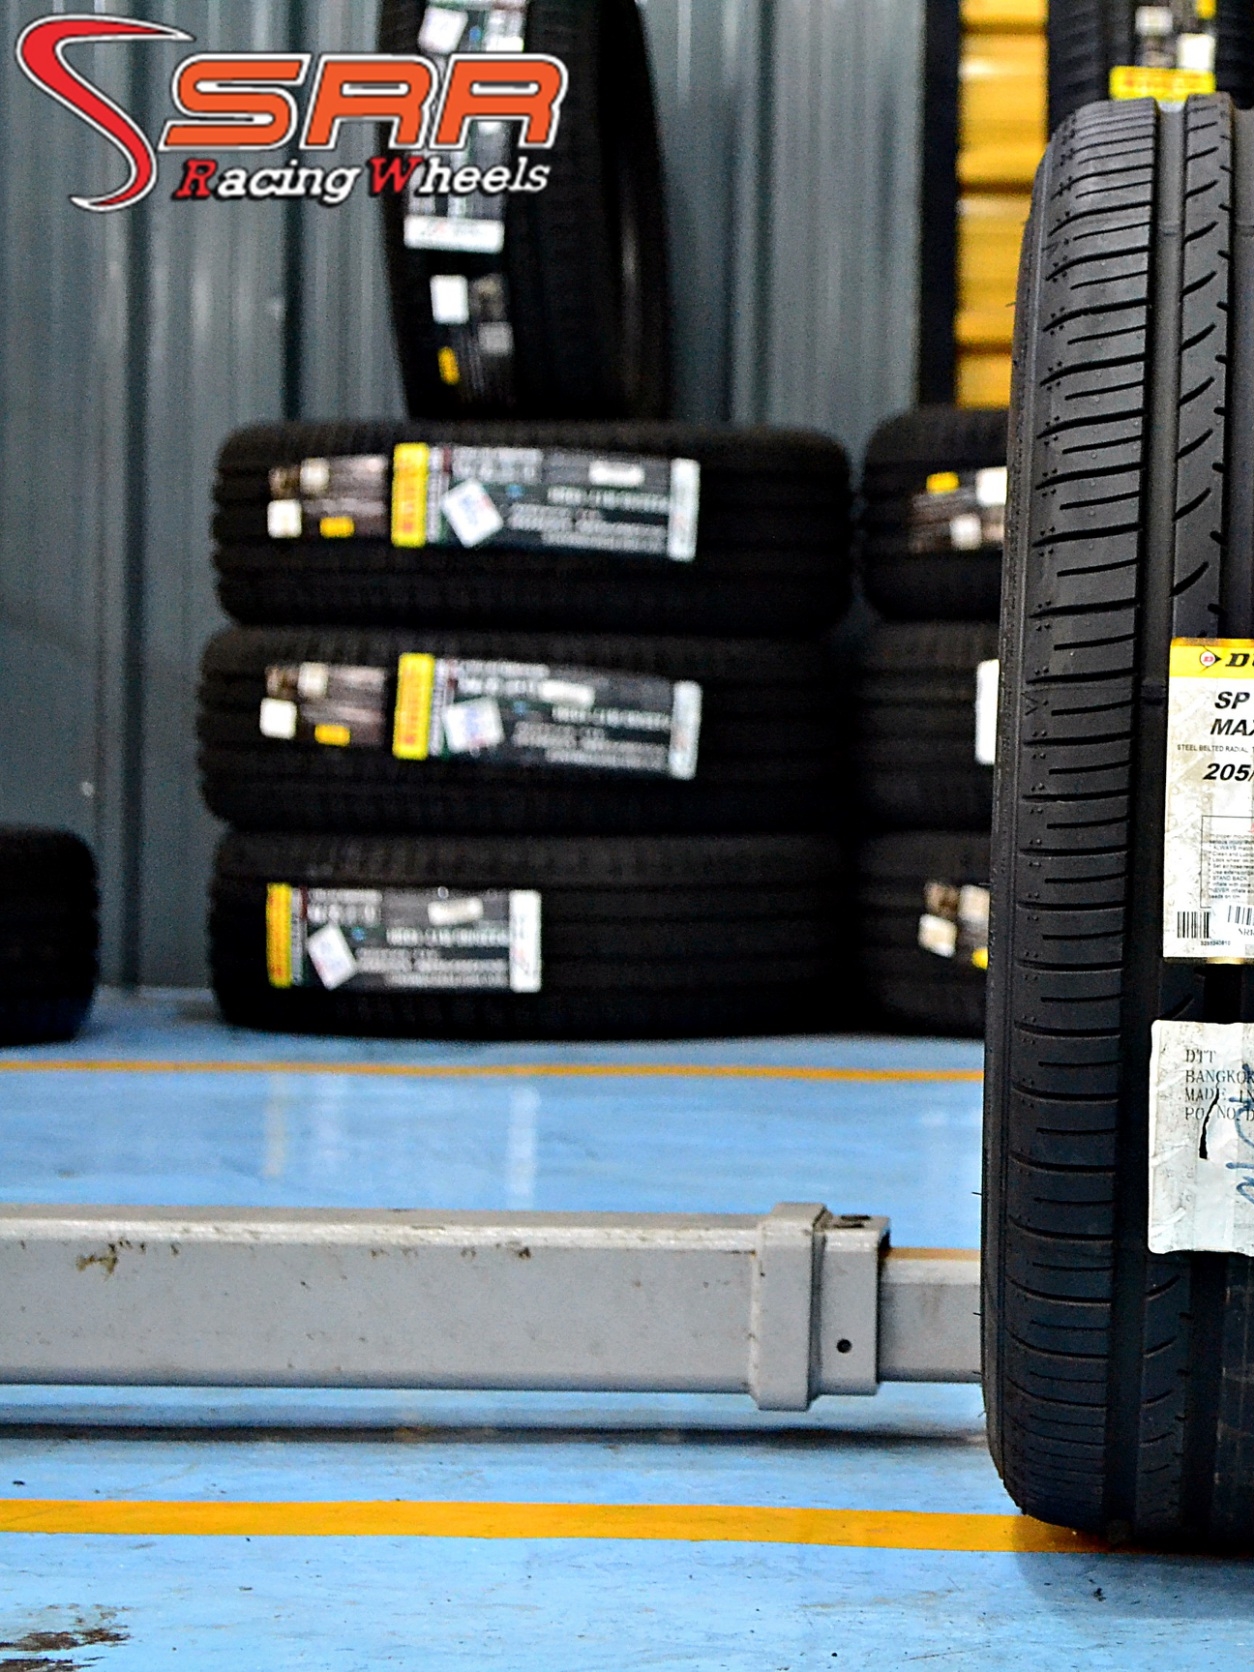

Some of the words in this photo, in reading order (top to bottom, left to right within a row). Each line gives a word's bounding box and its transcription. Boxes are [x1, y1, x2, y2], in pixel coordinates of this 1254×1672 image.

[1214, 691, 1250, 710] SP
[1177, 743, 1198, 752] STEEL
[1199, 744, 1224, 752] BELTED
